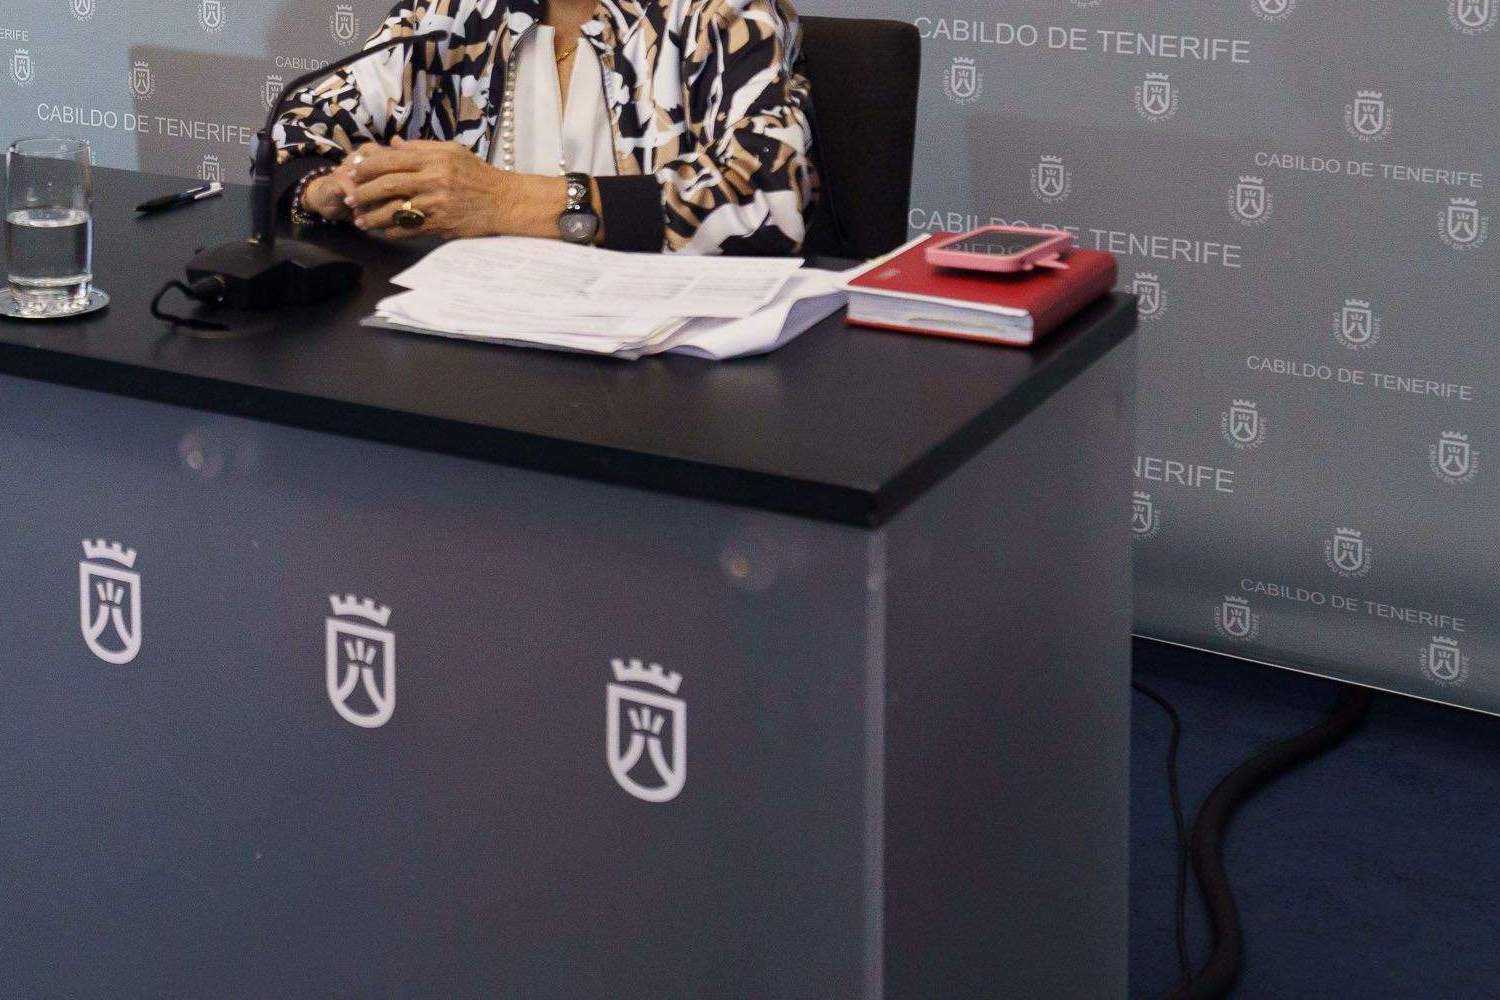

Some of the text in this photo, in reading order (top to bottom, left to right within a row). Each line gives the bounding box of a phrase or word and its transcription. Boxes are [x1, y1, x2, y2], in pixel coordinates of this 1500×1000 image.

[913, 17, 1250, 64] CABILDO DE TENERIFE
[36, 102, 251, 146] CABILDO DE TENERIFE
[1253, 151, 1482, 189] CABILDO DE TENERIFE
[1088, 229, 1242, 269] TENERIFE
[1245, 355, 1472, 401] CABILDO DE TENERIFE
[1240, 578, 1465, 632] CABILDO DE TENERIFE
